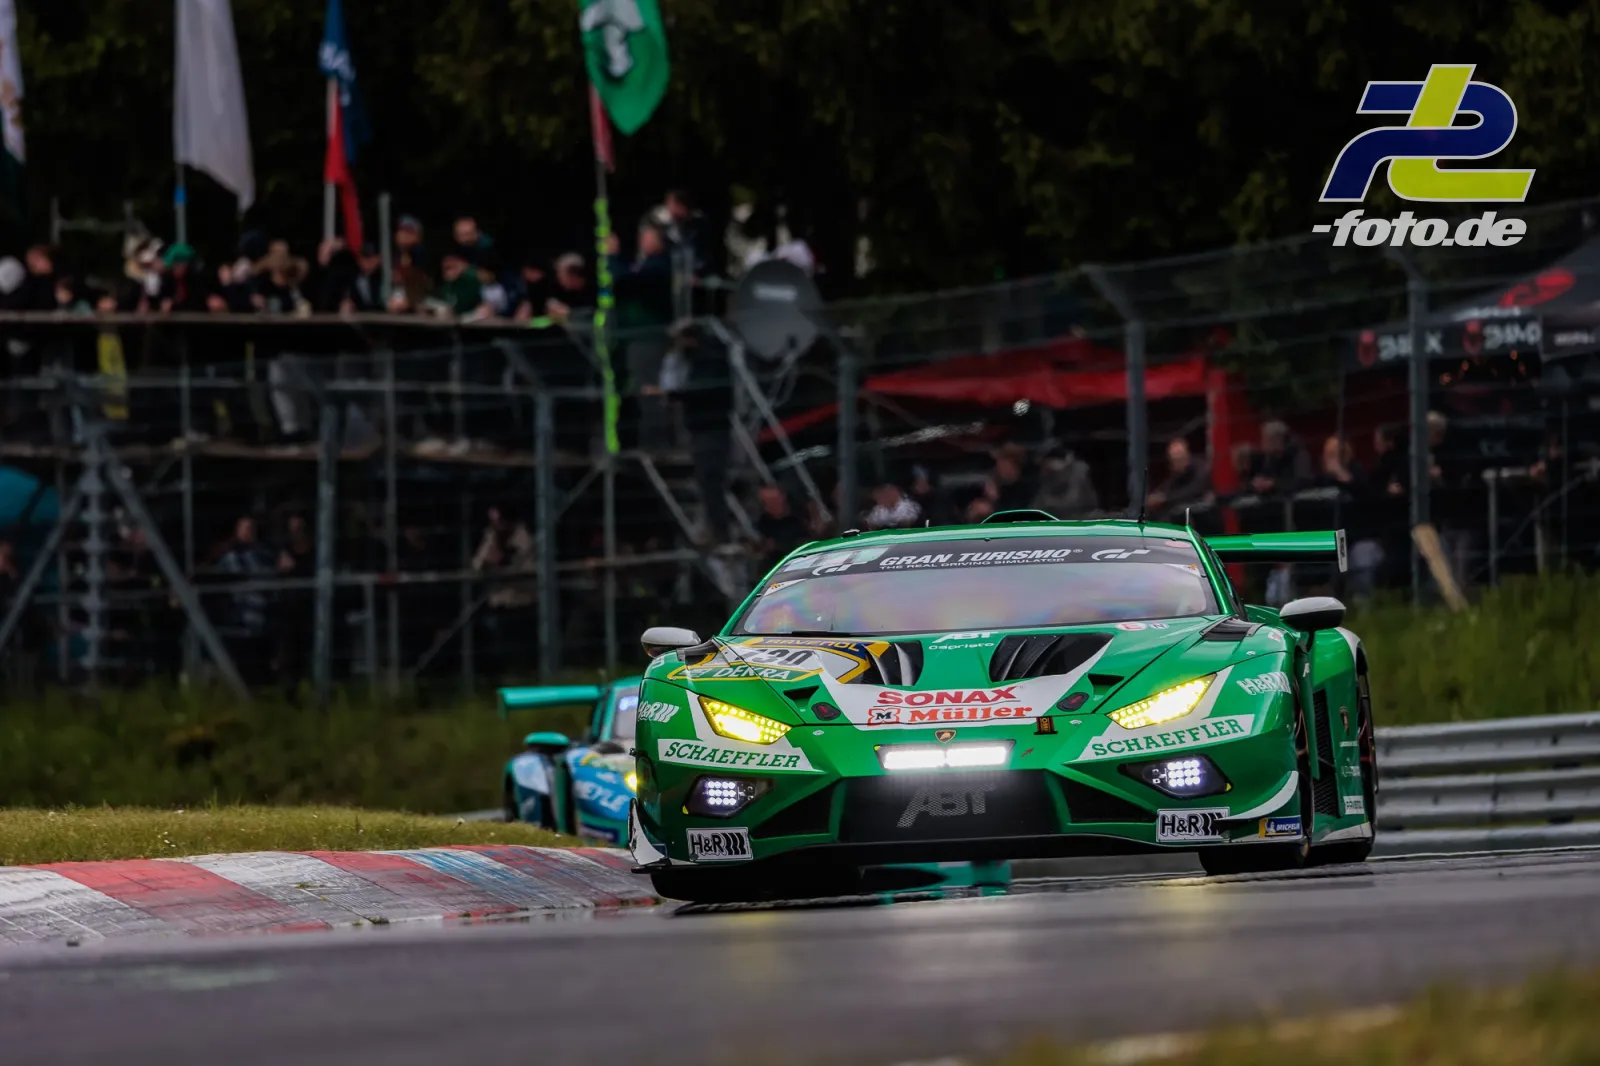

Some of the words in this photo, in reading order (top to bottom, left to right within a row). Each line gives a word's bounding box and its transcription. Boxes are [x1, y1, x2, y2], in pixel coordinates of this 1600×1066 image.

[879, 553, 954, 567] GRAN
[957, 548, 1072, 562] TURISMO
[940, 560, 991, 568] DRIVING
[994, 557, 1065, 565] SIMULATOR
[717, 664, 791, 680] DEKRA
[876, 685, 1017, 706] SONAX
[875, 711, 892, 721] M
[908, 706, 1033, 723] Müller
[1091, 718, 1244, 756] SCHAEFFLER
[664, 741, 801, 768] SCHAEFFLER
[896, 784, 997, 828] ABT
[1160, 814, 1201, 836] H&R
[690, 833, 725, 856] H&R
